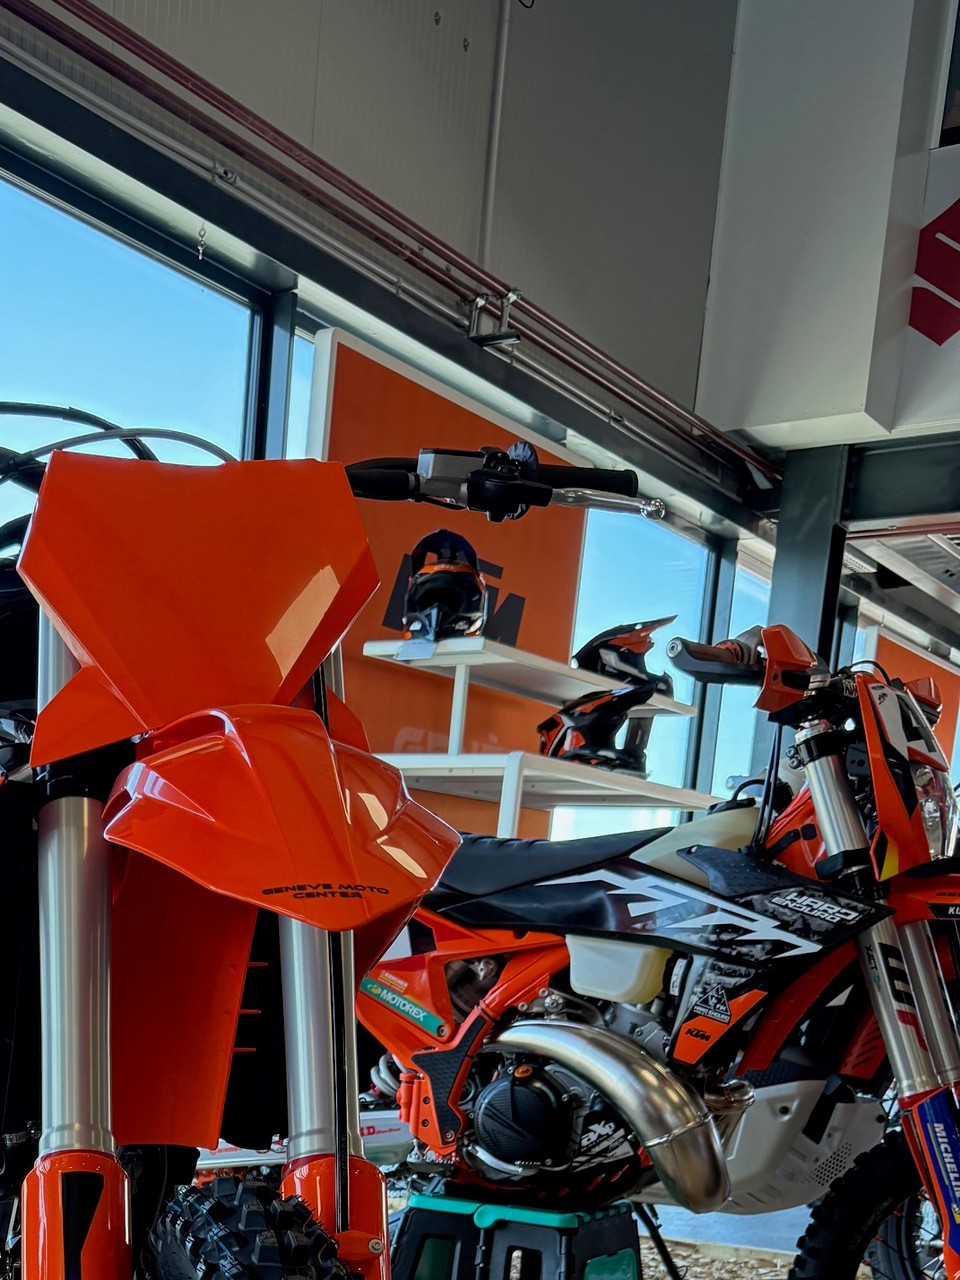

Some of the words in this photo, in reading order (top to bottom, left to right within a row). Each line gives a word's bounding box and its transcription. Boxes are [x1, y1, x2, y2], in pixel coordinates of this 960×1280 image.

[261, 883, 333, 895] GENEVE
[338, 883, 389, 894] MOTO
[293, 891, 363, 899] CENTER
[771, 896, 841, 923] ENDURO
[785, 892, 860, 922] HARD
[379, 988, 427, 1022] MOTOREX
[684, 1027, 712, 1042] KTM
